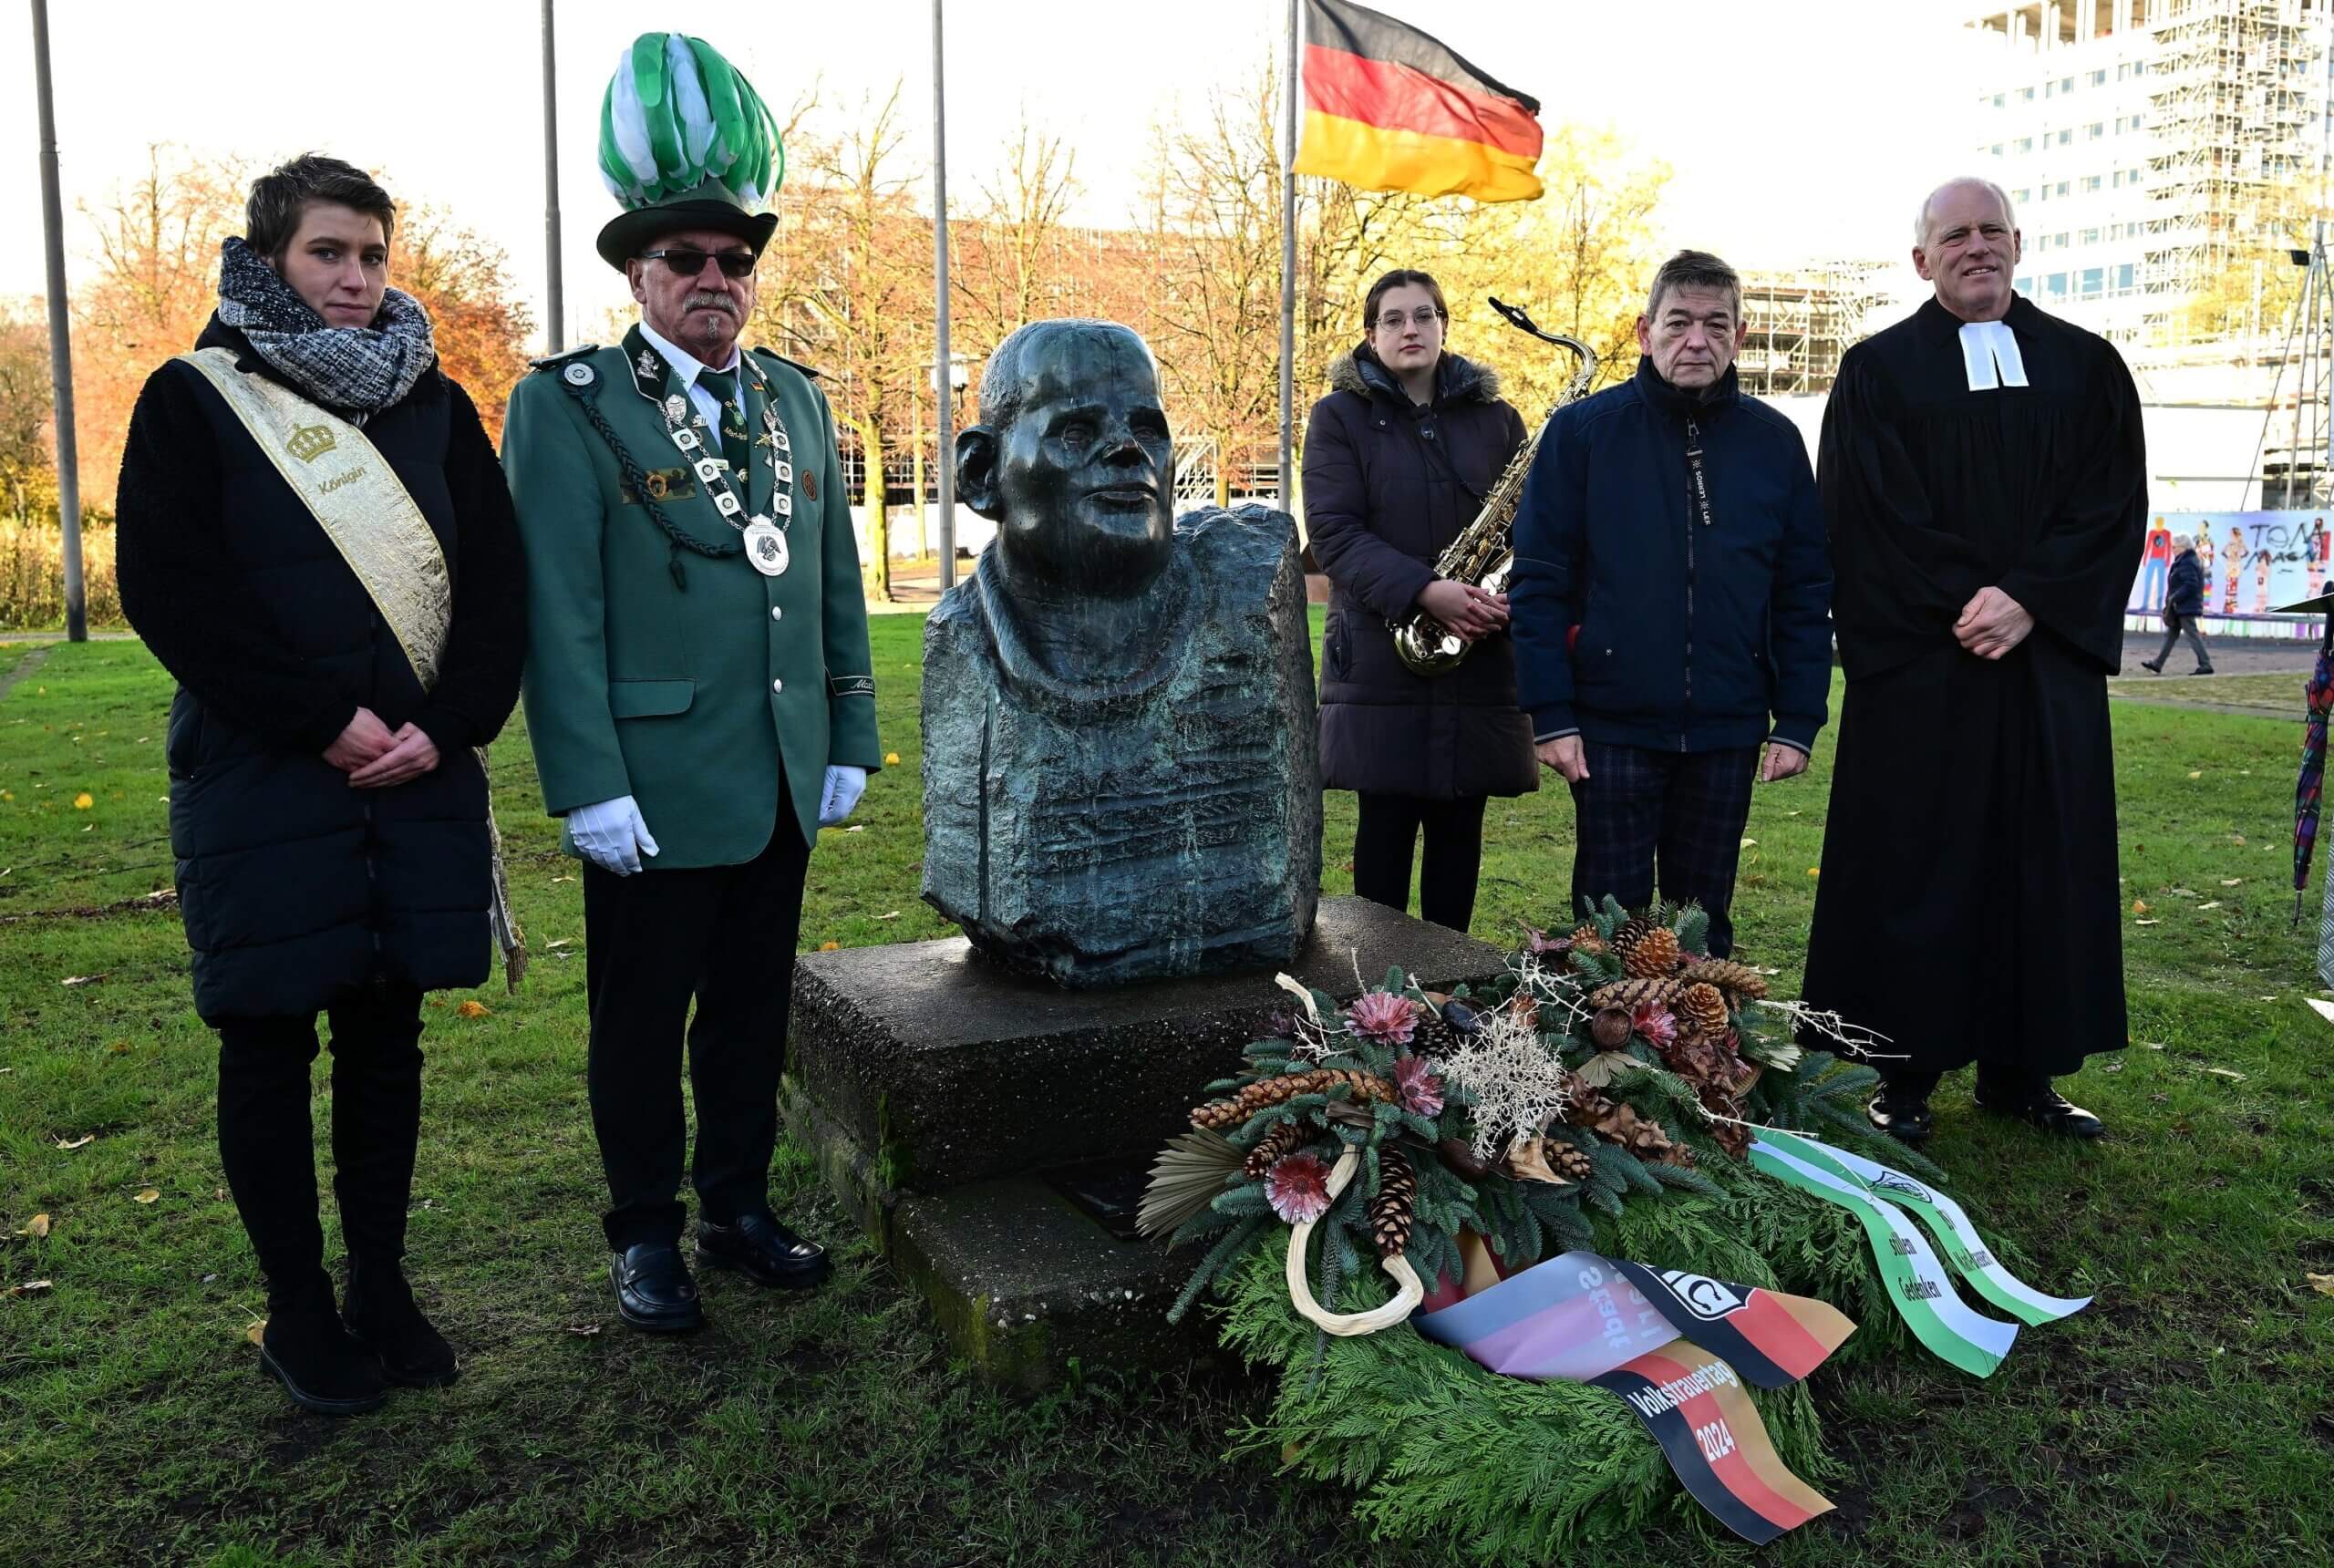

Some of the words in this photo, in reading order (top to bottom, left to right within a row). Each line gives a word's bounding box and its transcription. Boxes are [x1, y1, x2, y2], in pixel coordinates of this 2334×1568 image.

[318, 466, 367, 495] Königin
[1898, 1274, 1942, 1302] Gedenken
[1627, 1361, 1738, 1418] Volkstrauertag
[1697, 1418, 1736, 1461] 2024
